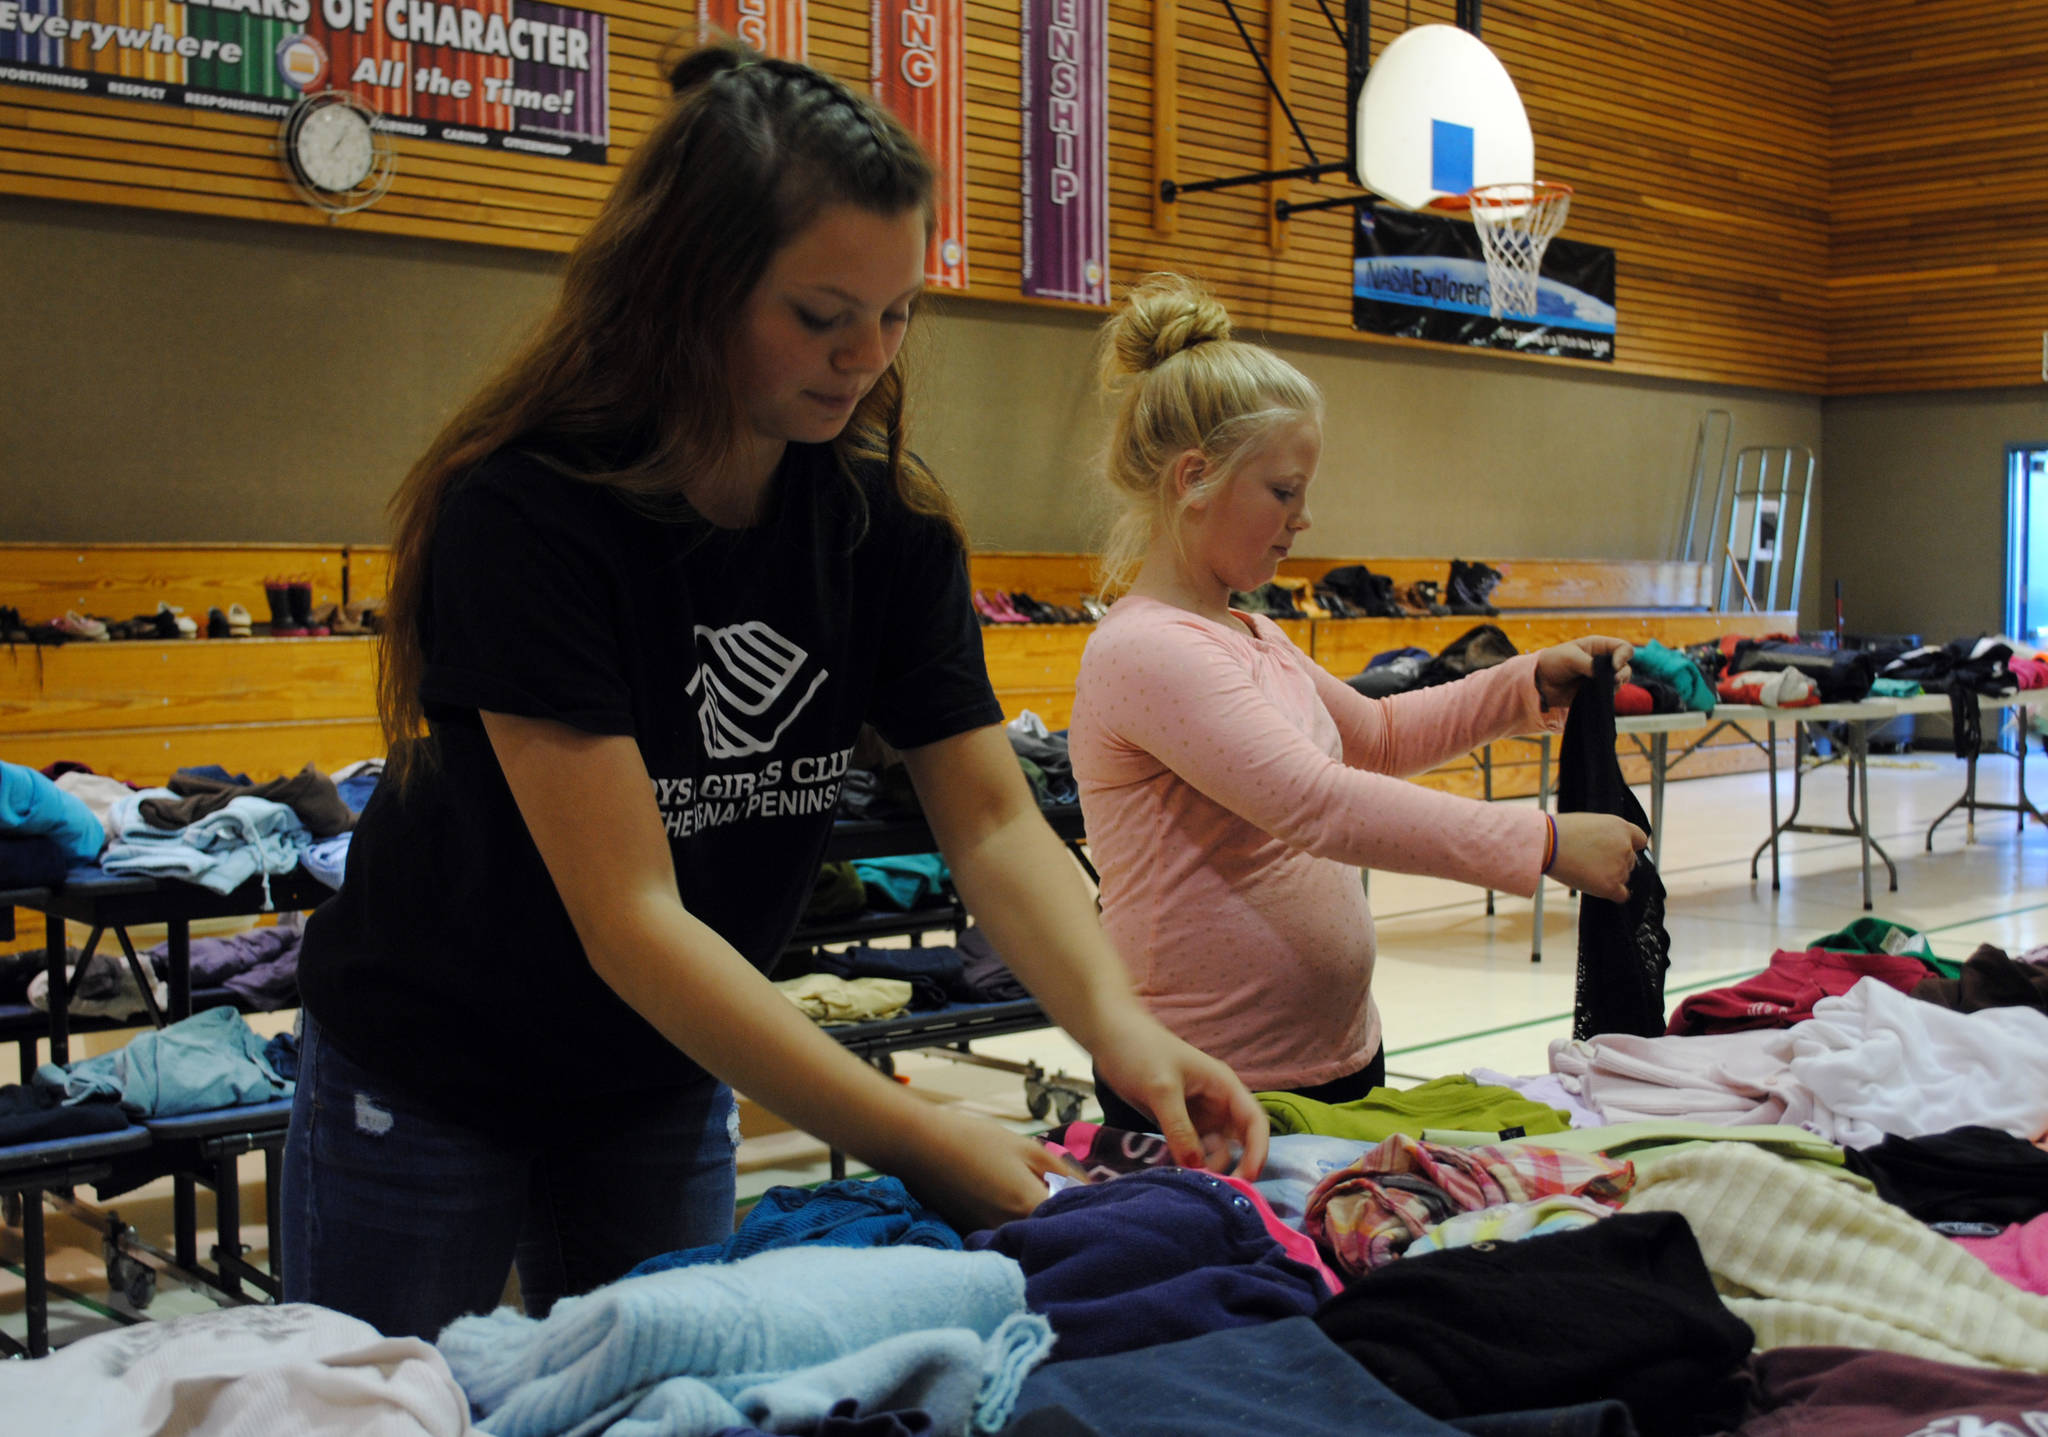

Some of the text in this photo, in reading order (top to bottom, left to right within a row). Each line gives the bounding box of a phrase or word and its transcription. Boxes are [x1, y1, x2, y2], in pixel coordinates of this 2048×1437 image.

[0, 2, 243, 63] Everywhere
[322, 0, 373, 32] OF
[385, 0, 590, 70] CHARACTER
[108, 82, 166, 100] RESPECT
[352, 58, 405, 87] All
[415, 67, 472, 98] the
[484, 77, 575, 115] Time!
[792, 746, 855, 783] CLU
[747, 782, 841, 819] PENINS
